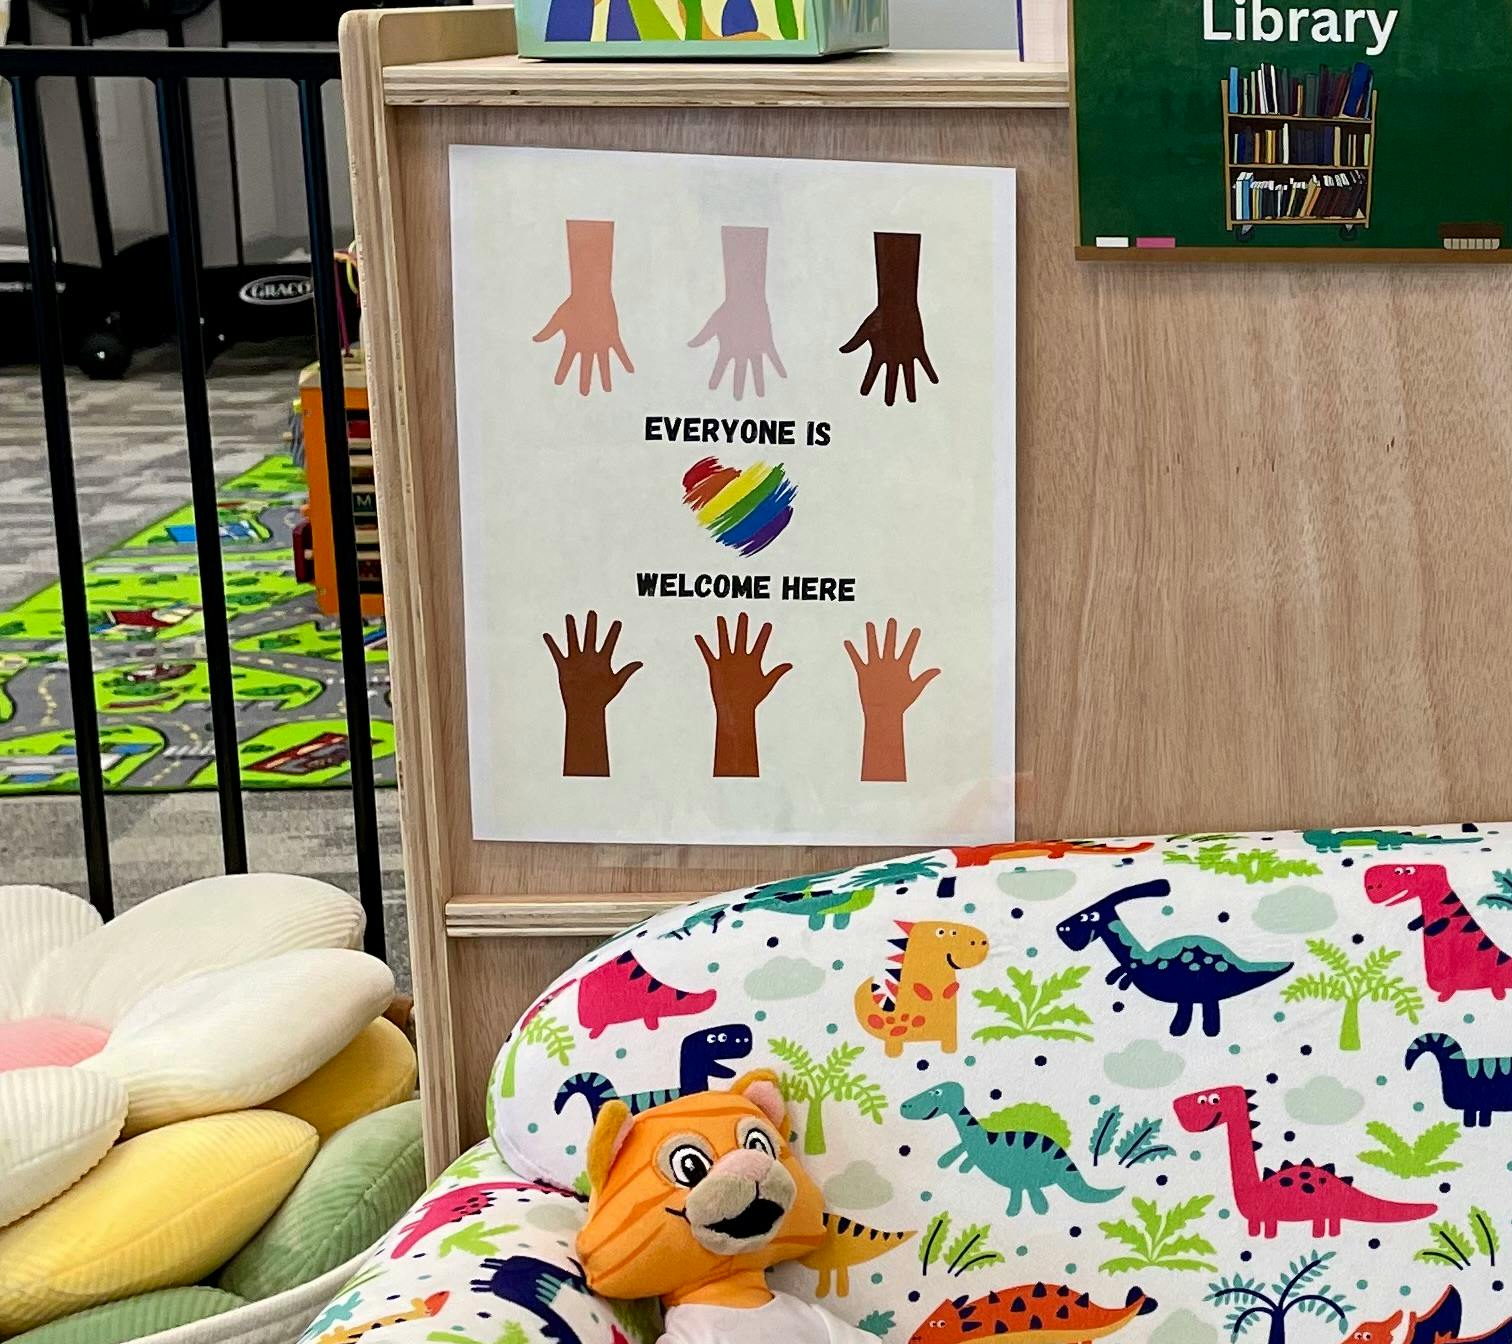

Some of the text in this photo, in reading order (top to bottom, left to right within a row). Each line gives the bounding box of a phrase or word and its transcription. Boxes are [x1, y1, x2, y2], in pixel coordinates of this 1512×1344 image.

[250, 279, 312, 299] GRACO
[645, 416, 832, 446] EVERYONE IS
[636, 572, 856, 602] WELCOME HERE
